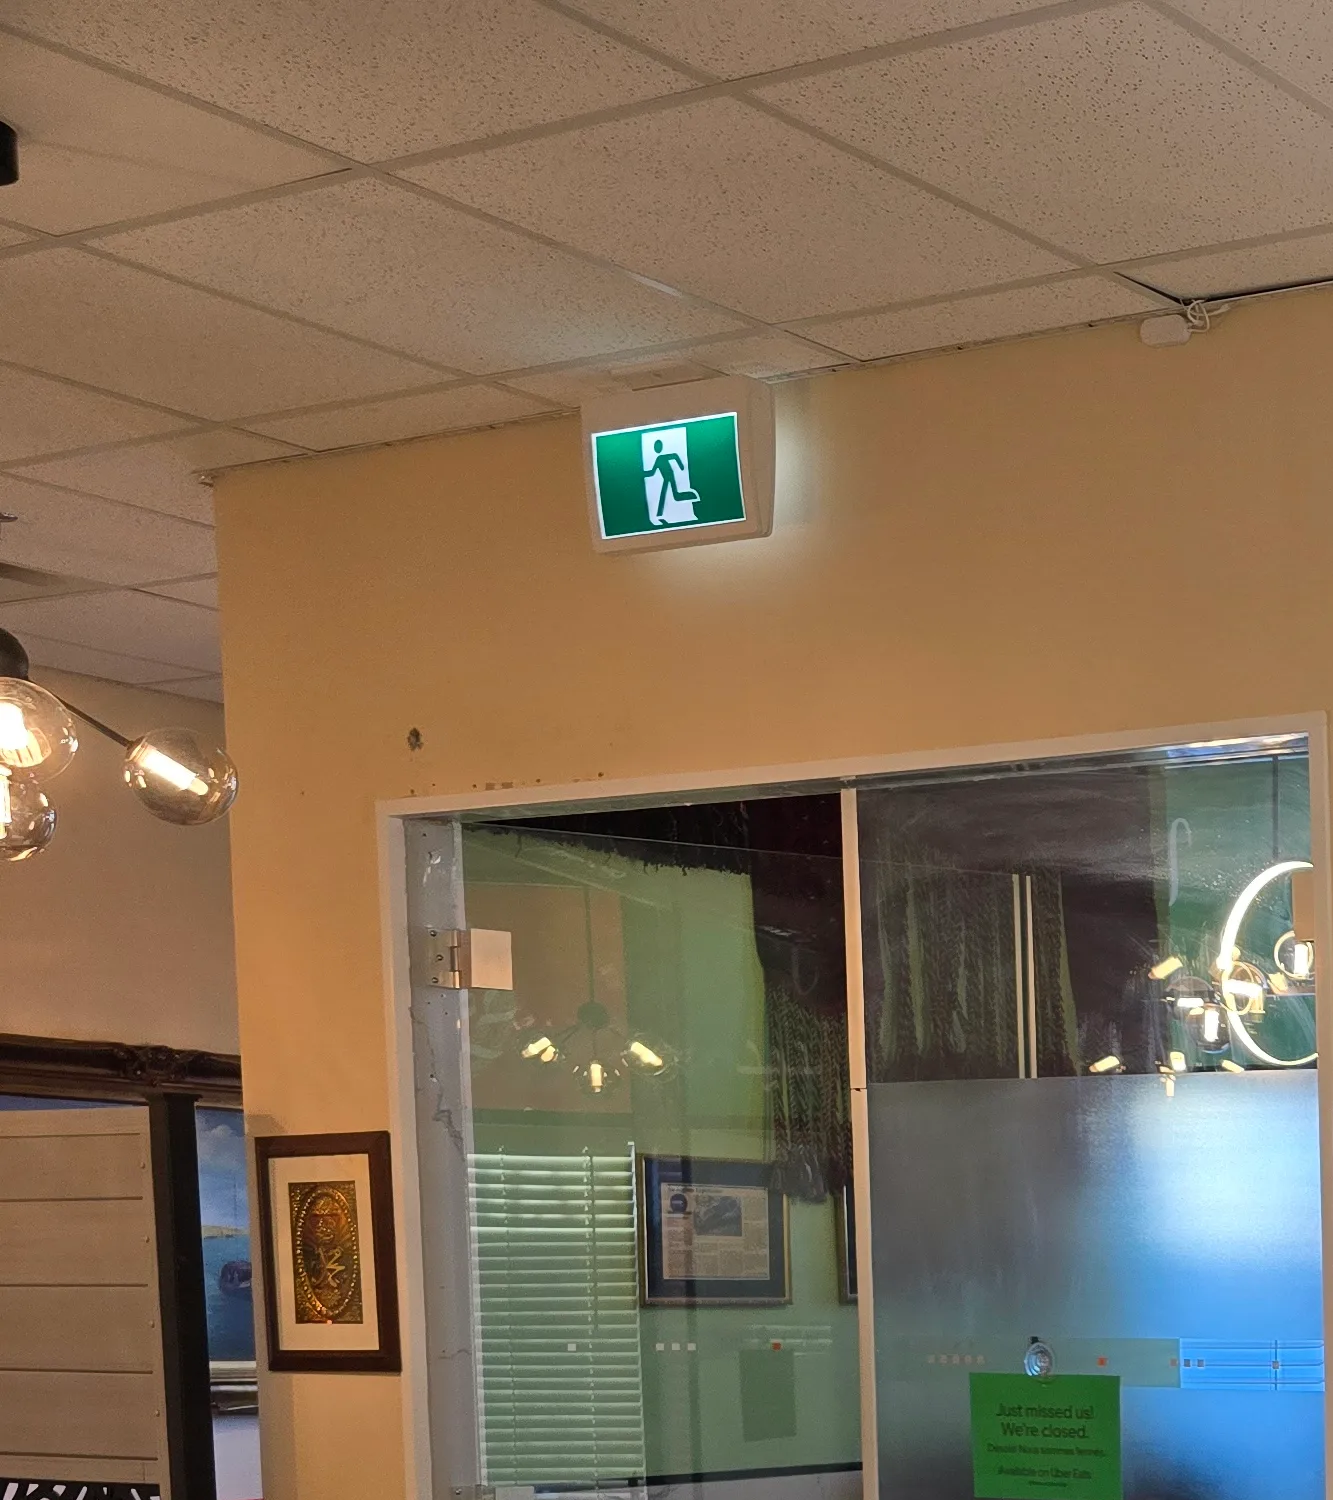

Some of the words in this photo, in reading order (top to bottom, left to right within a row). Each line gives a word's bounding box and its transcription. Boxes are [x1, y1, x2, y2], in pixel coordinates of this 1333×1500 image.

[996, 1403, 1023, 1418] Just
[1025, 1404, 1073, 1419] missed
[1075, 1405, 1095, 1420] us!
[1001, 1422, 1039, 1437] We're
